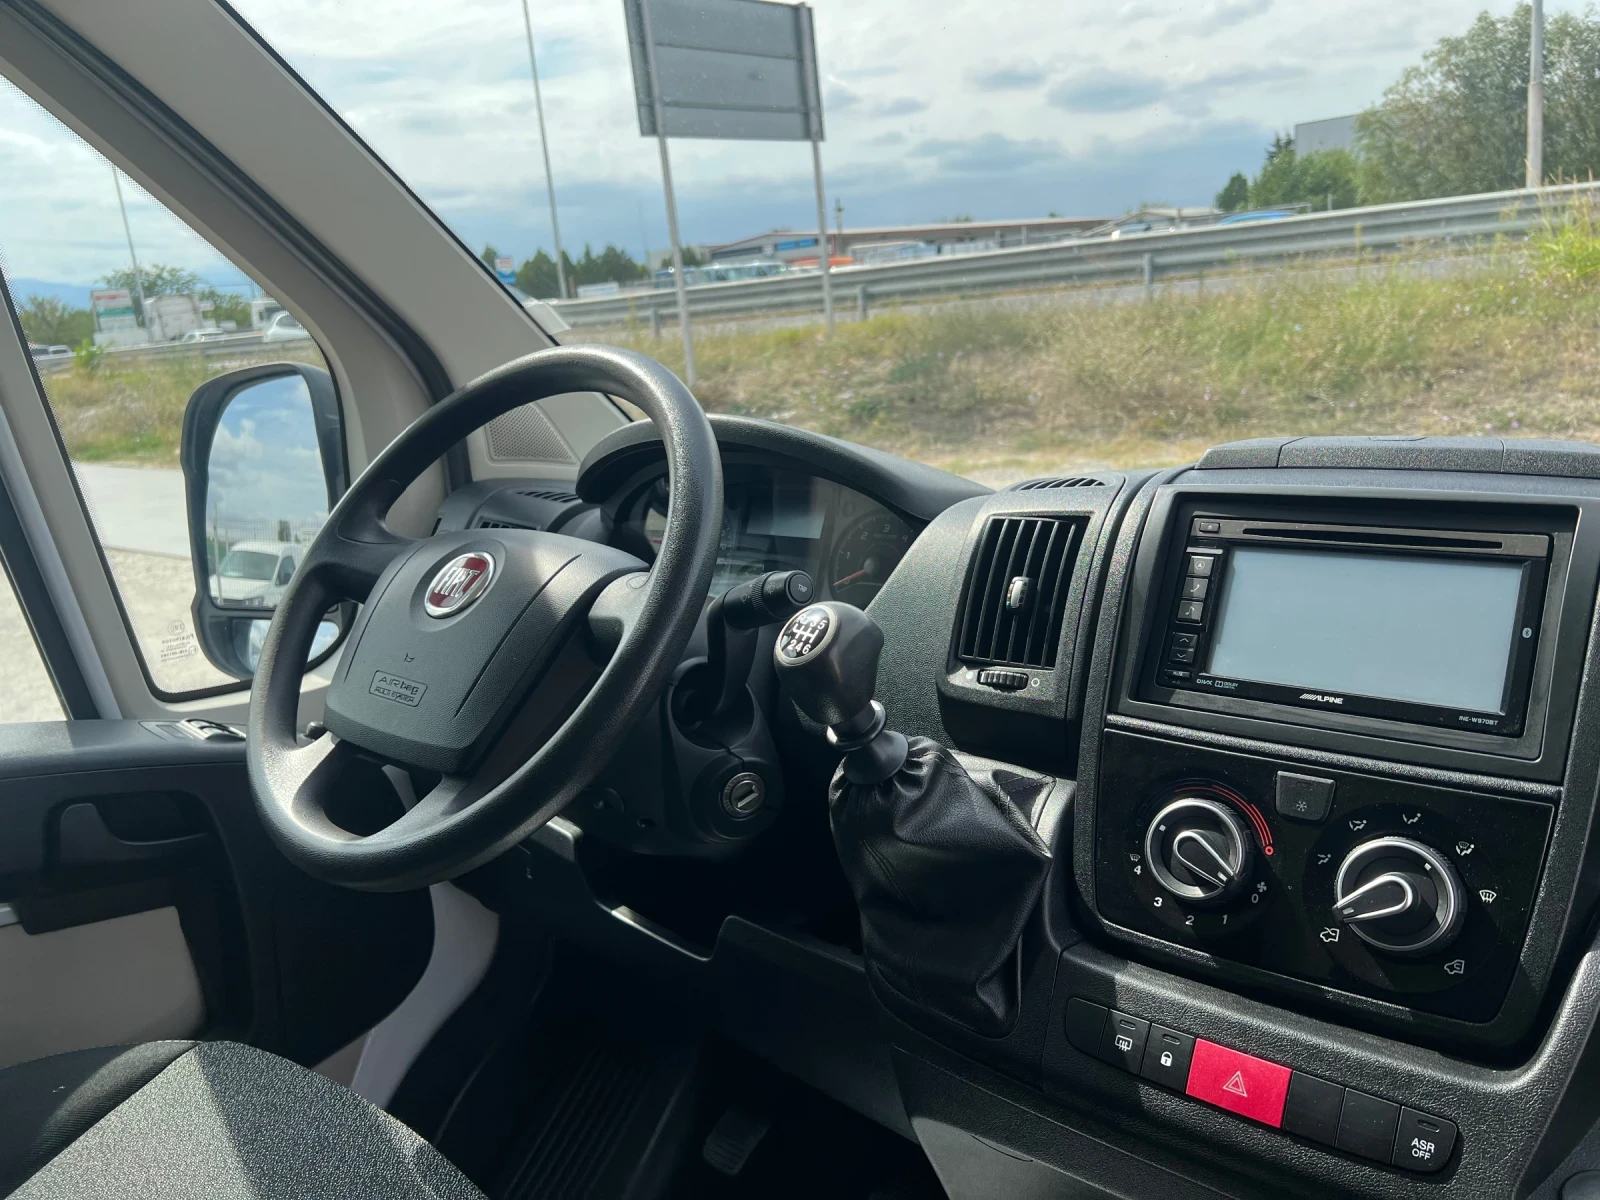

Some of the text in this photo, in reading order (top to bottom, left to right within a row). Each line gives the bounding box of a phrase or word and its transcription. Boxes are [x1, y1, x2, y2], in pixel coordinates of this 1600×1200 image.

[883, 524, 891, 533] 3
[860, 531, 868, 540] 2
[434, 566, 480, 598] FIAT
[817, 619, 827, 630] 5
[788, 639, 812, 655] 2 4 6
[1308, 693, 1344, 705] ALPINE
[1133, 865, 1142, 875] 4
[1153, 896, 1163, 907] 3
[1251, 893, 1259, 904] 0
[1185, 915, 1195, 926] 2
[1222, 914, 1228, 925] 1
[1410, 1137, 1435, 1153] ASR
[1411, 1148, 1431, 1160] OFF
